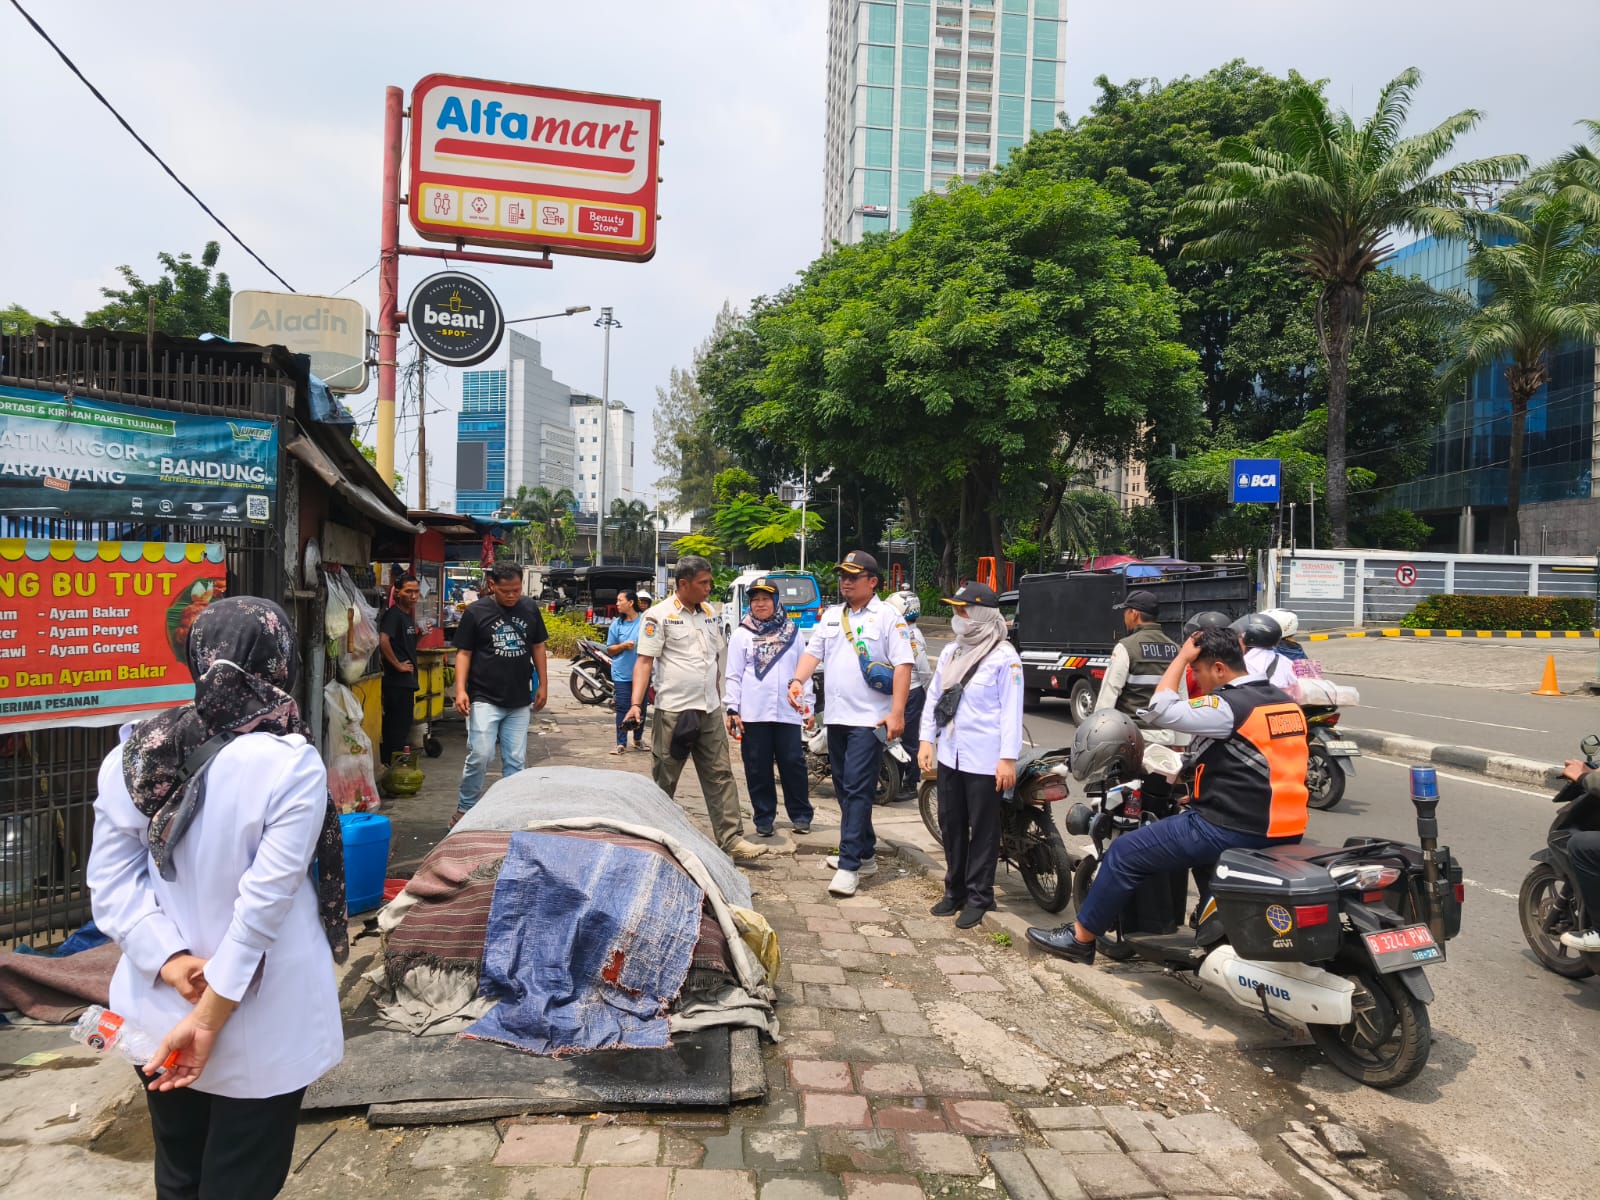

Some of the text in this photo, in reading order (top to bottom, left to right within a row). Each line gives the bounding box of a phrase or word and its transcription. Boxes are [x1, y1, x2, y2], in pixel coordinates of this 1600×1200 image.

[436, 95, 639, 153] Alfamart
[589, 211, 625, 226] Beauty
[592, 222, 619, 234] Store
[249, 308, 348, 336] Aladin
[423, 304, 486, 330] bean!
[441, 329, 467, 337] SPOT
[38, 406, 46, 415] &
[94, 413, 124, 425] PAKET
[0, 430, 139, 461] ATINANGOR
[1, 460, 127, 485] ARAWANG
[160, 457, 266, 483] BANDUNG
[1250, 474, 1276, 487] BCA
[52, 571, 97, 598] BU
[108, 571, 178, 597] TUT
[49, 608, 89, 622] Ayam
[92, 606, 131, 619] Bakar
[49, 626, 89, 640] Ayam
[92, 624, 139, 638] Penyet
[49, 644, 89, 658] Ayam
[93, 642, 140, 656] Goreng
[1142, 644, 1177, 657] POL PP
[16, 671, 54, 688] Dan
[59, 667, 113, 687] Ayam
[117, 663, 168, 680] Bakar
[45, 695, 100, 710] PESANAN
[1370, 938, 1380, 953] B
[1381, 933, 1410, 950] 3242
[1238, 974, 1291, 1001] DISHUB
